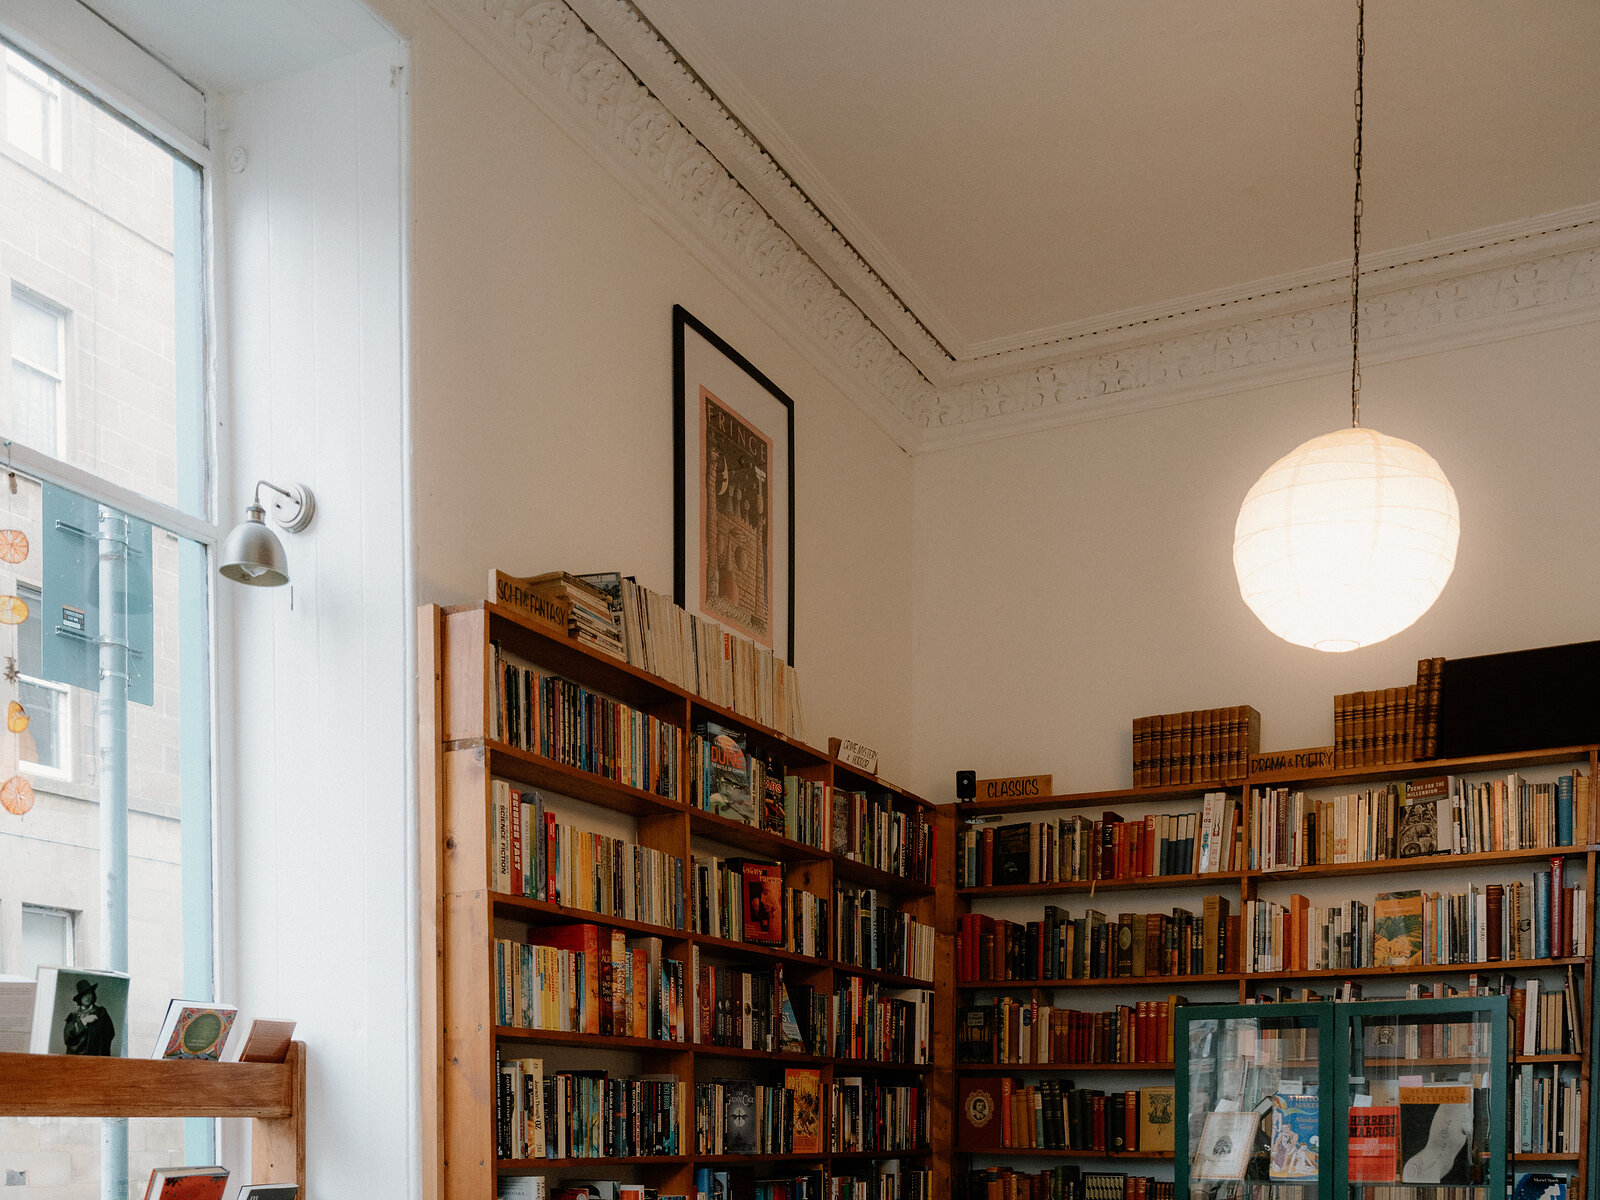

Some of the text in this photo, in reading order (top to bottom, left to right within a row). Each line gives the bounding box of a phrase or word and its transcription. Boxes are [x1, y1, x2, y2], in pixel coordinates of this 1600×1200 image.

[706, 403, 768, 463] FRINGE
[530, 594, 566, 627] FANTASY
[843, 739, 878, 760] CRIME MYSTERY
[711, 745, 745, 770] DUNE
[852, 755, 870, 769] HORROR
[1251, 751, 1334, 774] DRAMA & POETRY
[765, 779, 782, 793] ARS
[987, 778, 1039, 798] CLASSICS
[1406, 782, 1424, 793] POEMS
[1425, 782, 1435, 790] FOR
[1406, 788, 1438, 799] MILLENNIUM
[1401, 1095, 1467, 1103] WINTERSON
[535, 1120, 542, 1130] OZ
[1350, 1114, 1397, 1126] HERBERT
[1349, 1126, 1397, 1138] MARCUSE
